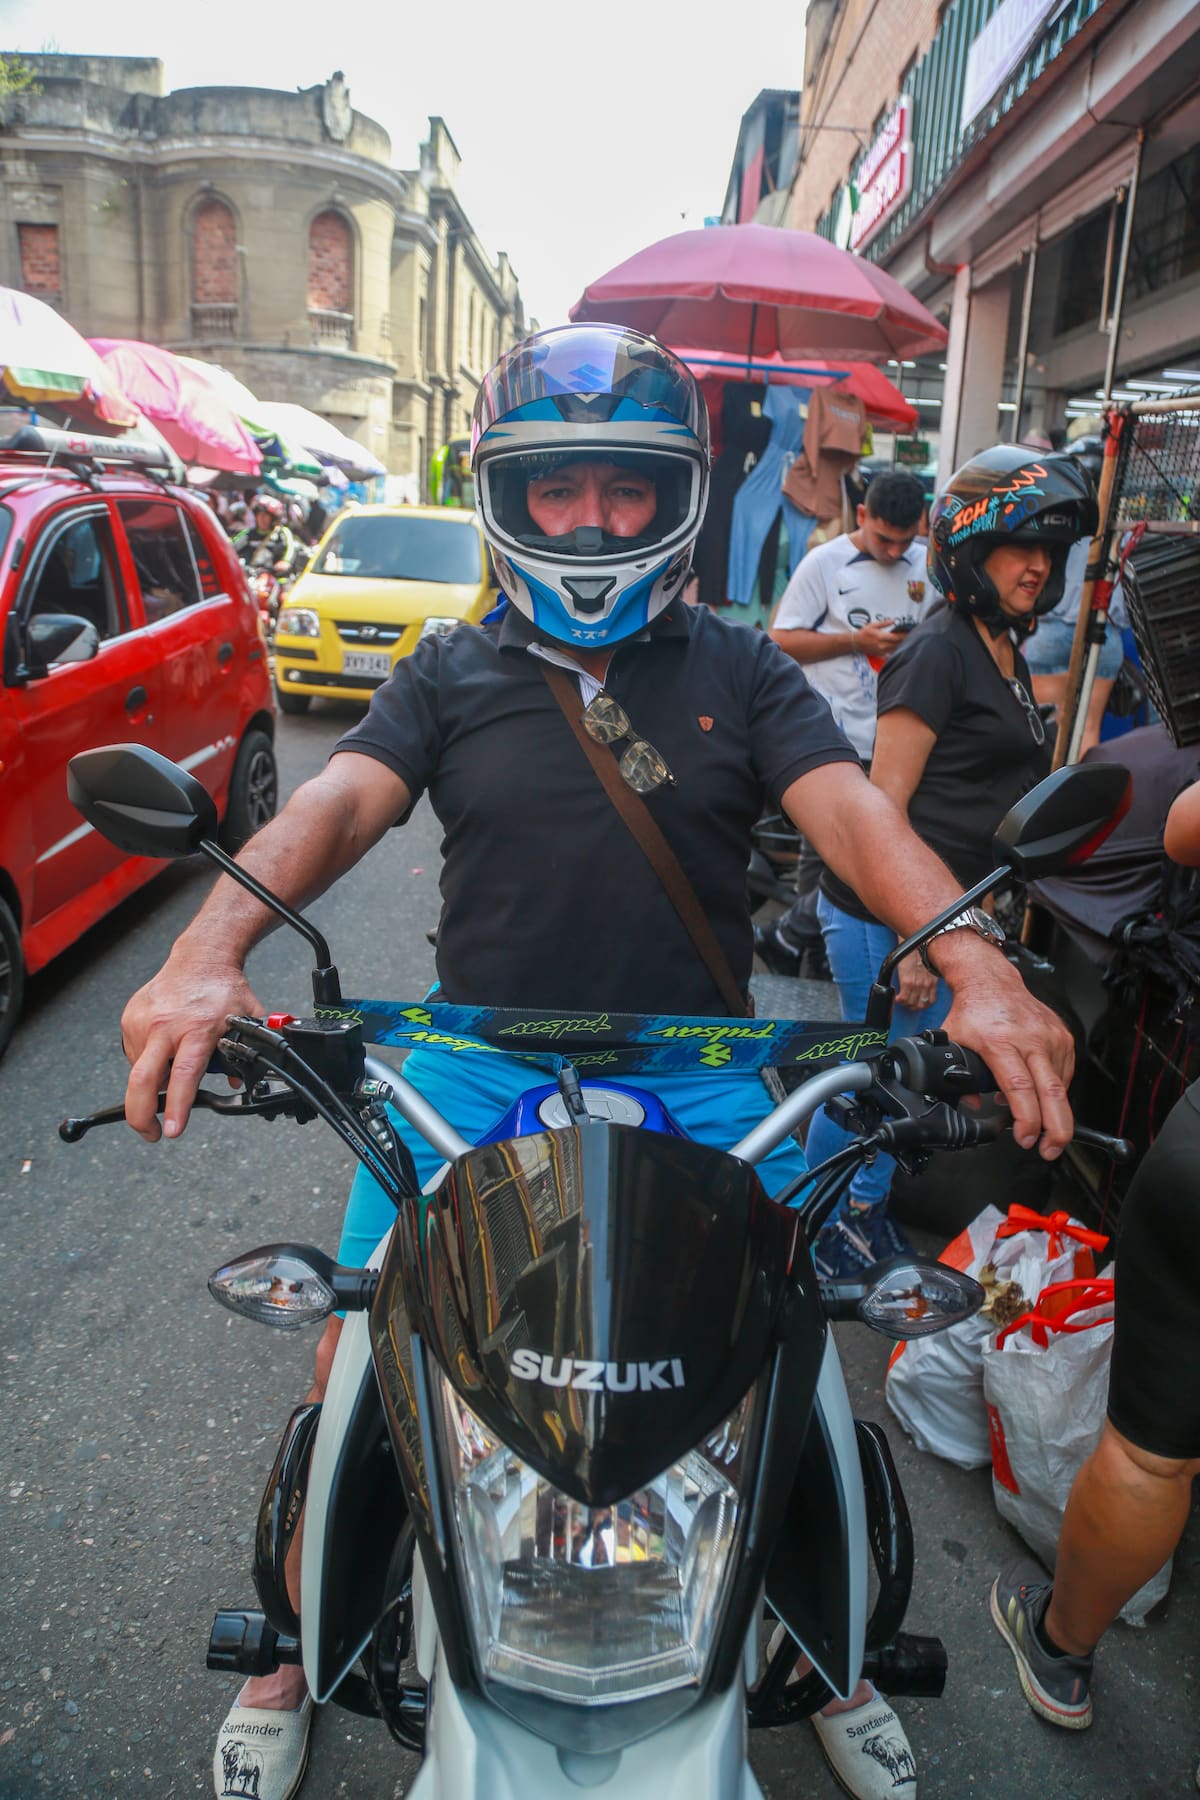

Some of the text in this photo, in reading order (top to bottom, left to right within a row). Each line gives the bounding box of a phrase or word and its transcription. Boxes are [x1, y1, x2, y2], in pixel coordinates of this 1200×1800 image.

[648, 1022, 776, 1042] pulsar
[510, 1348, 686, 1393] SUZUKI
[222, 1722, 284, 1737] Santander
[846, 1711, 896, 1738] Santander
